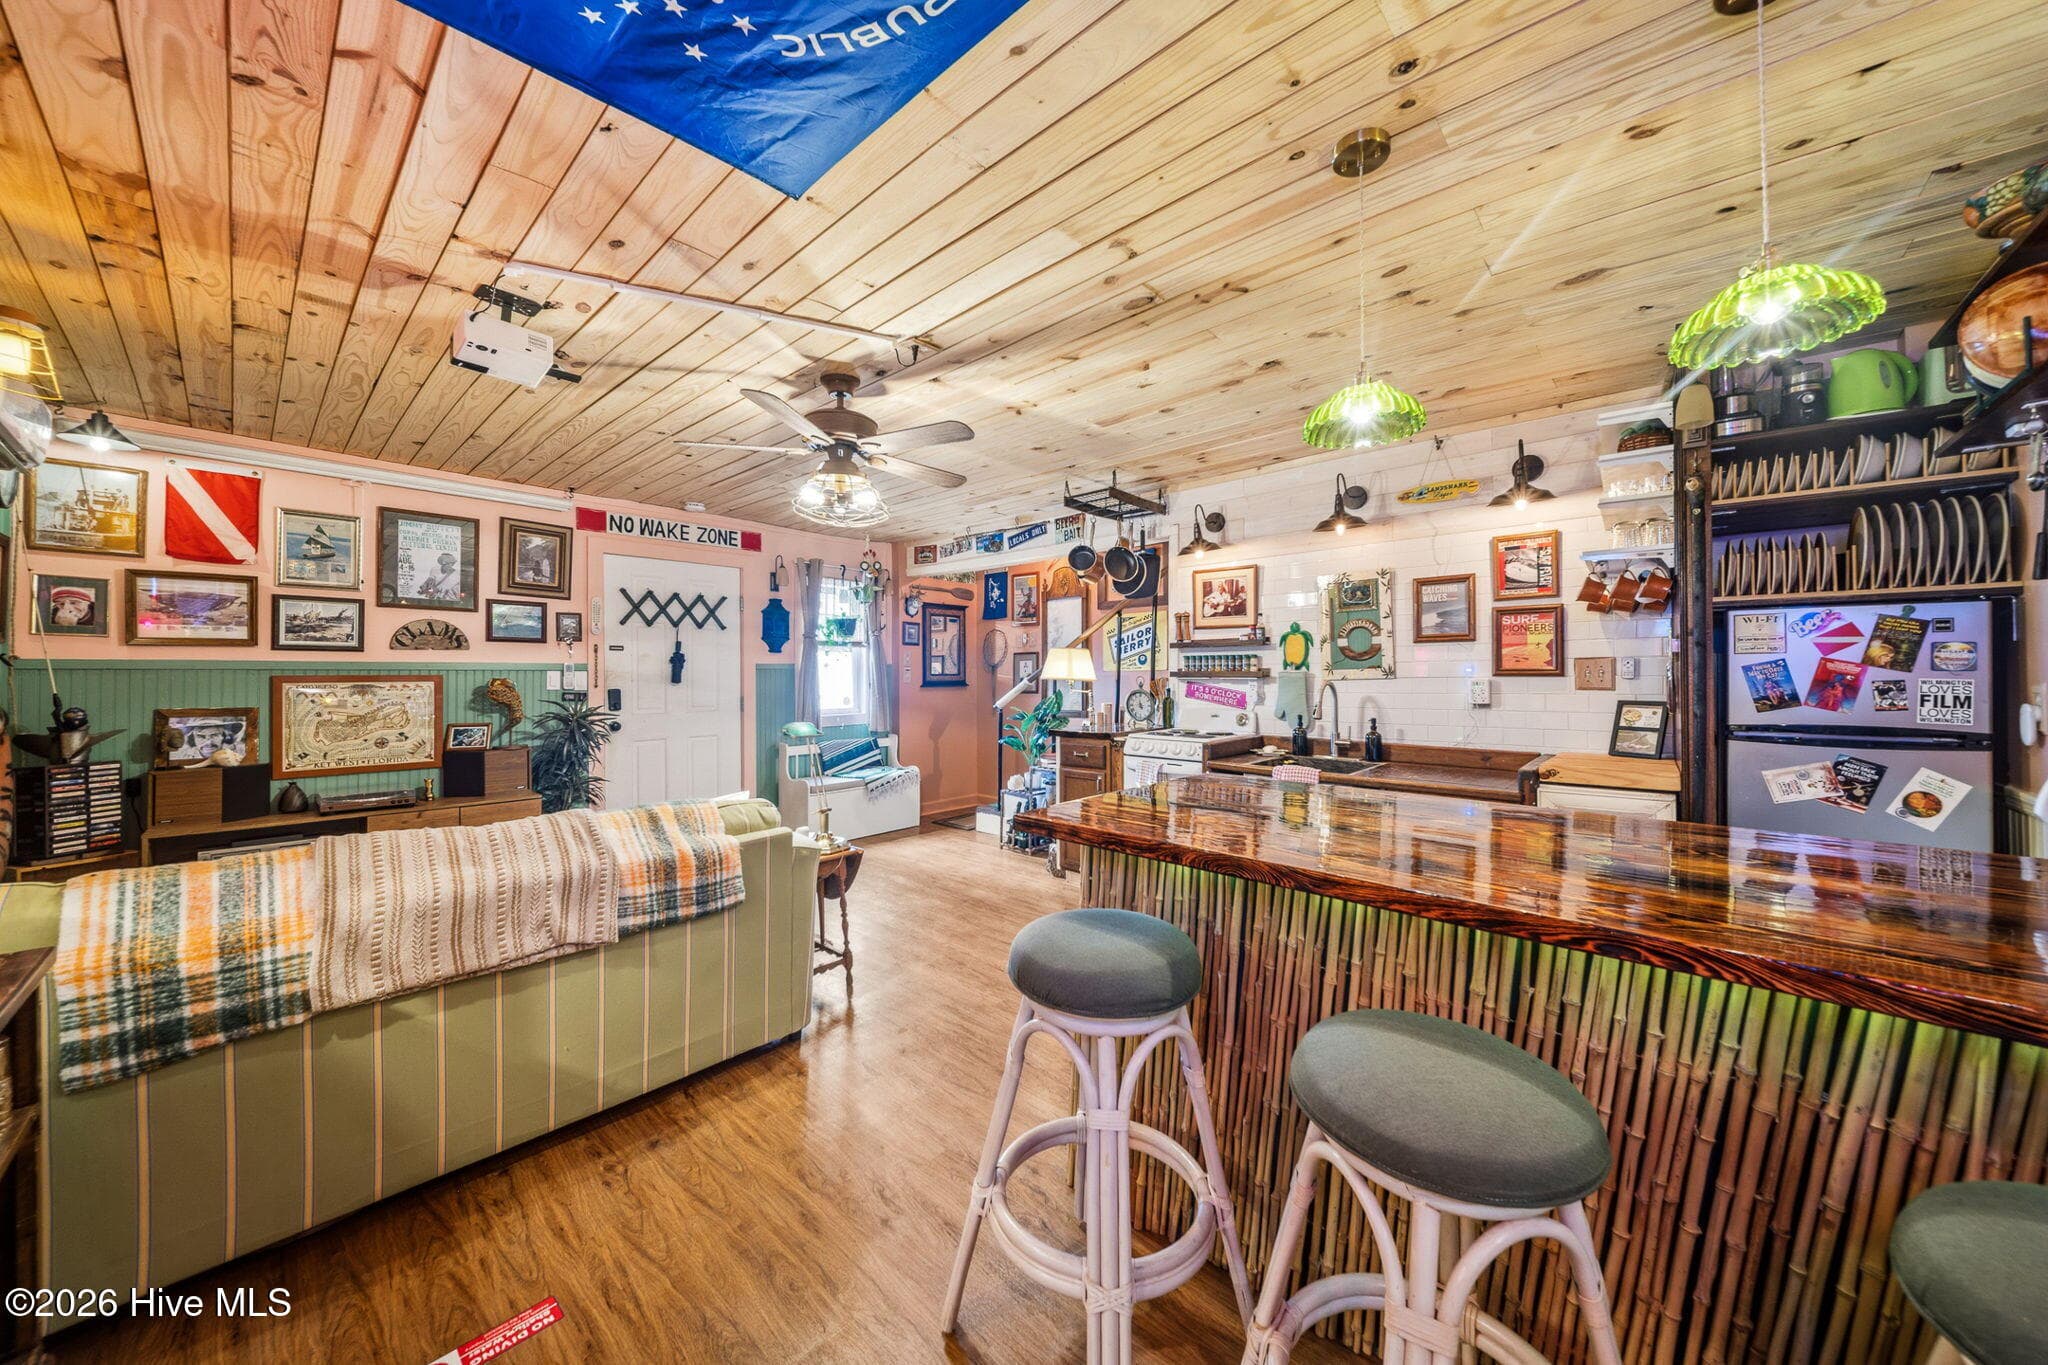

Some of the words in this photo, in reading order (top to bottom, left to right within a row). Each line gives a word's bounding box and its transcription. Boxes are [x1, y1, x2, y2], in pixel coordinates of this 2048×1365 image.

[609, 514, 634, 534] NO
[639, 518, 690, 541] WAKE
[696, 526, 738, 547] ZONE
[1064, 527, 1080, 542] BAIT
[1009, 532, 1030, 546] LOCALS
[1422, 594, 1448, 602] WAVES
[1502, 614, 1540, 624] SURF
[1502, 623, 1554, 632] PIONEERS
[395, 622, 468, 648] CLAMS
[1920, 685, 1973, 694] LOVES
[1920, 694, 1972, 709] FILM
[1919, 709, 1972, 718] LOVES
[366, 756, 409, 764] FLORIDA
[531, 1314, 555, 1332] NO
[469, 1332, 529, 1365] DIVING
